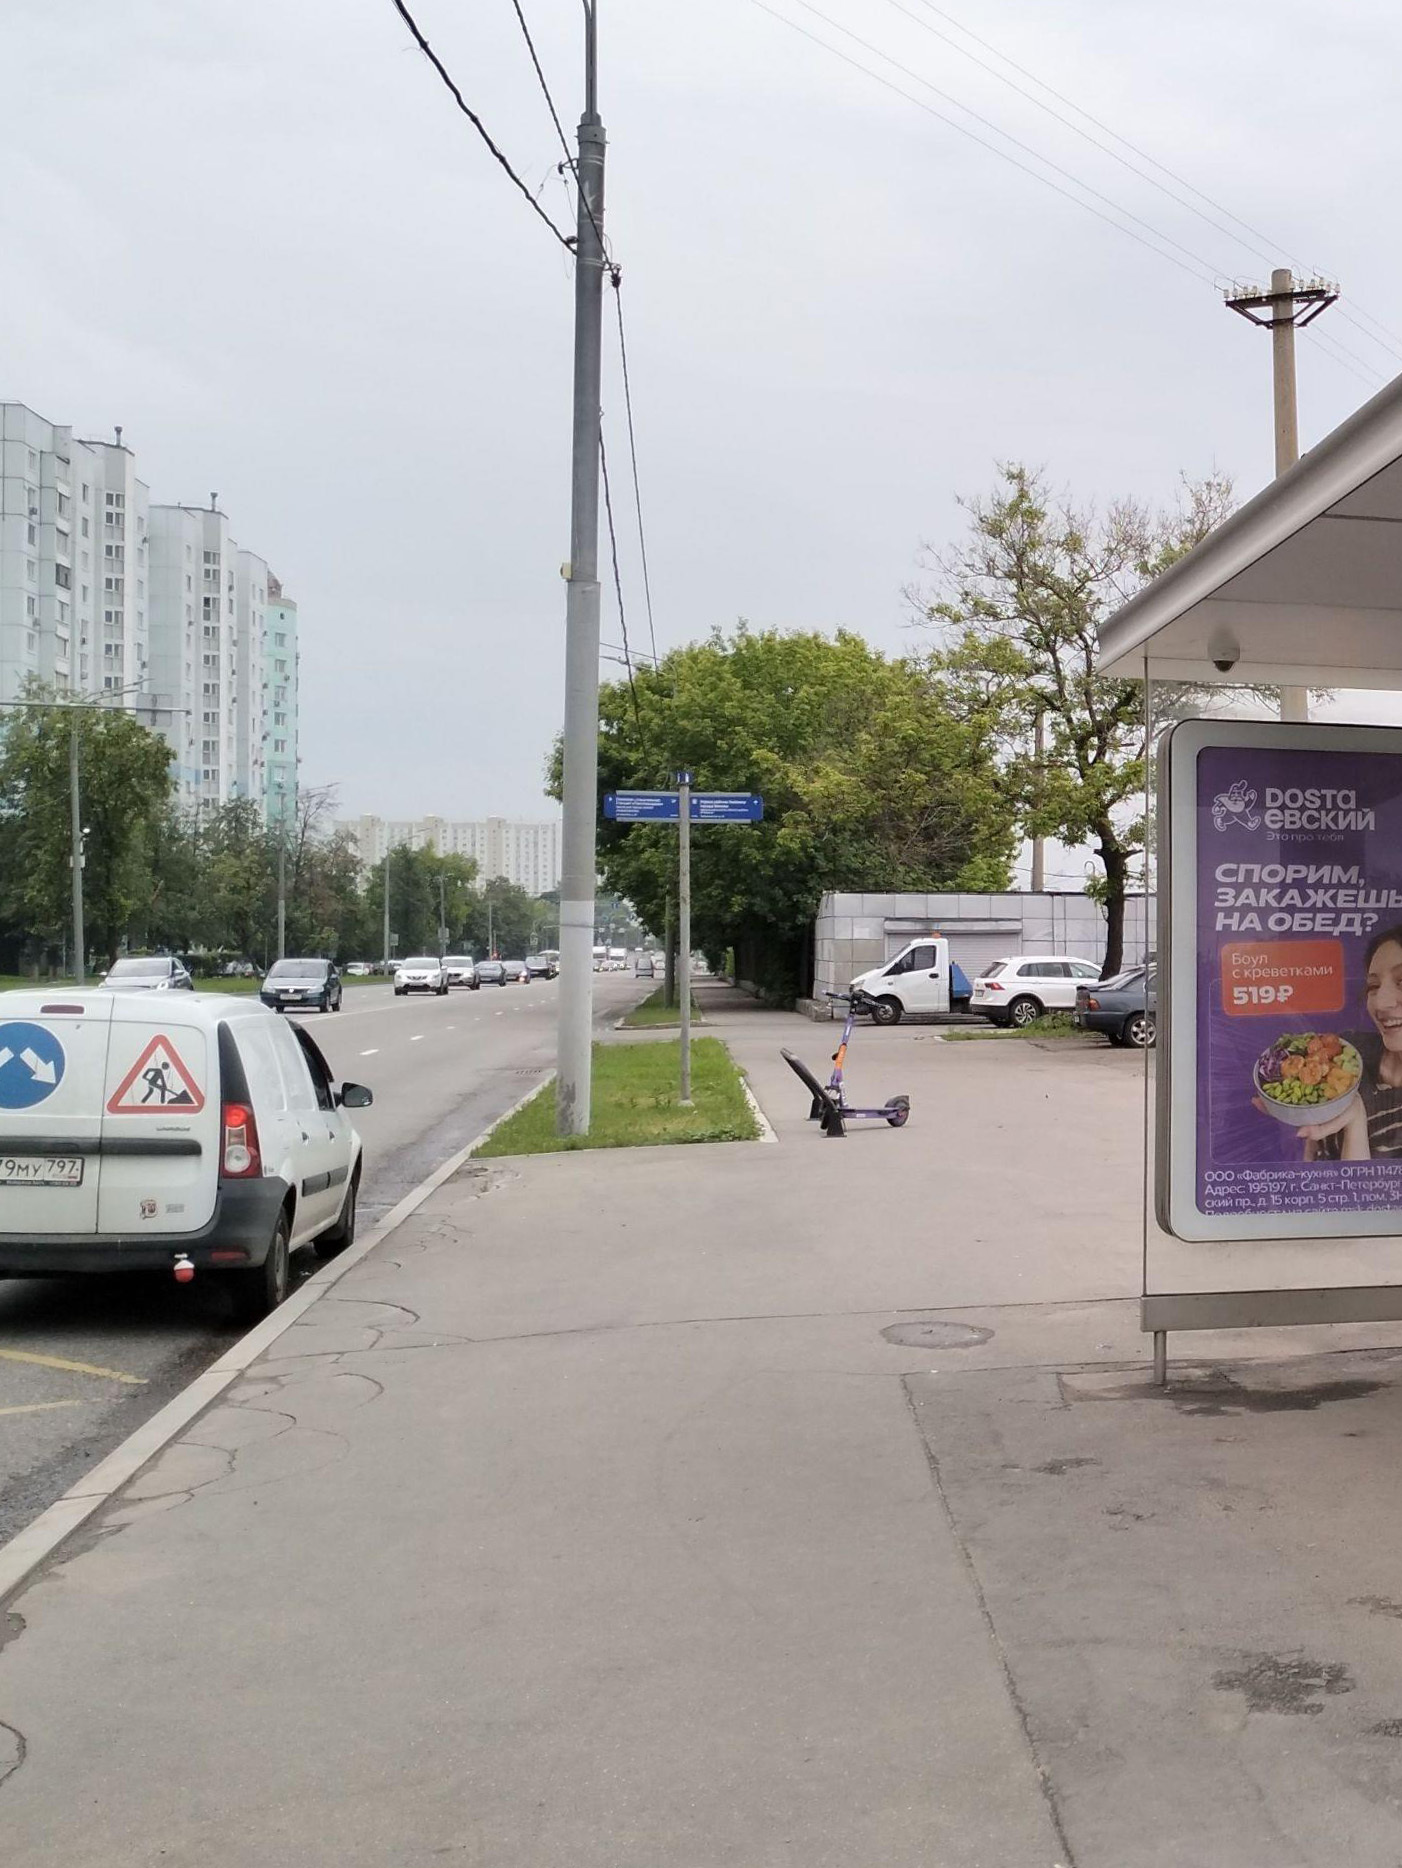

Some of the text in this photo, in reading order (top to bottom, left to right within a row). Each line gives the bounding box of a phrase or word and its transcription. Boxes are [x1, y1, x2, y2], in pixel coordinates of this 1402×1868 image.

[1266, 831, 1290, 841] Это
[1214, 863, 1366, 887] СПОРИМ,
[1215, 912, 1379, 937] НА ОБЕД?
[1231, 952, 1269, 968] Боул
[1232, 965, 1334, 981] с креветками
[1233, 984, 1294, 1005] 519₽
[47, 1159, 77, 1174] 797
[1204, 1170, 1235, 1182] ООО
[1340, 1166, 1375, 1178] ОГРН
[1204, 1197, 1234, 1209] ский
[1270, 1194, 1283, 1206] 15
[1317, 1193, 1327, 1205] 5
